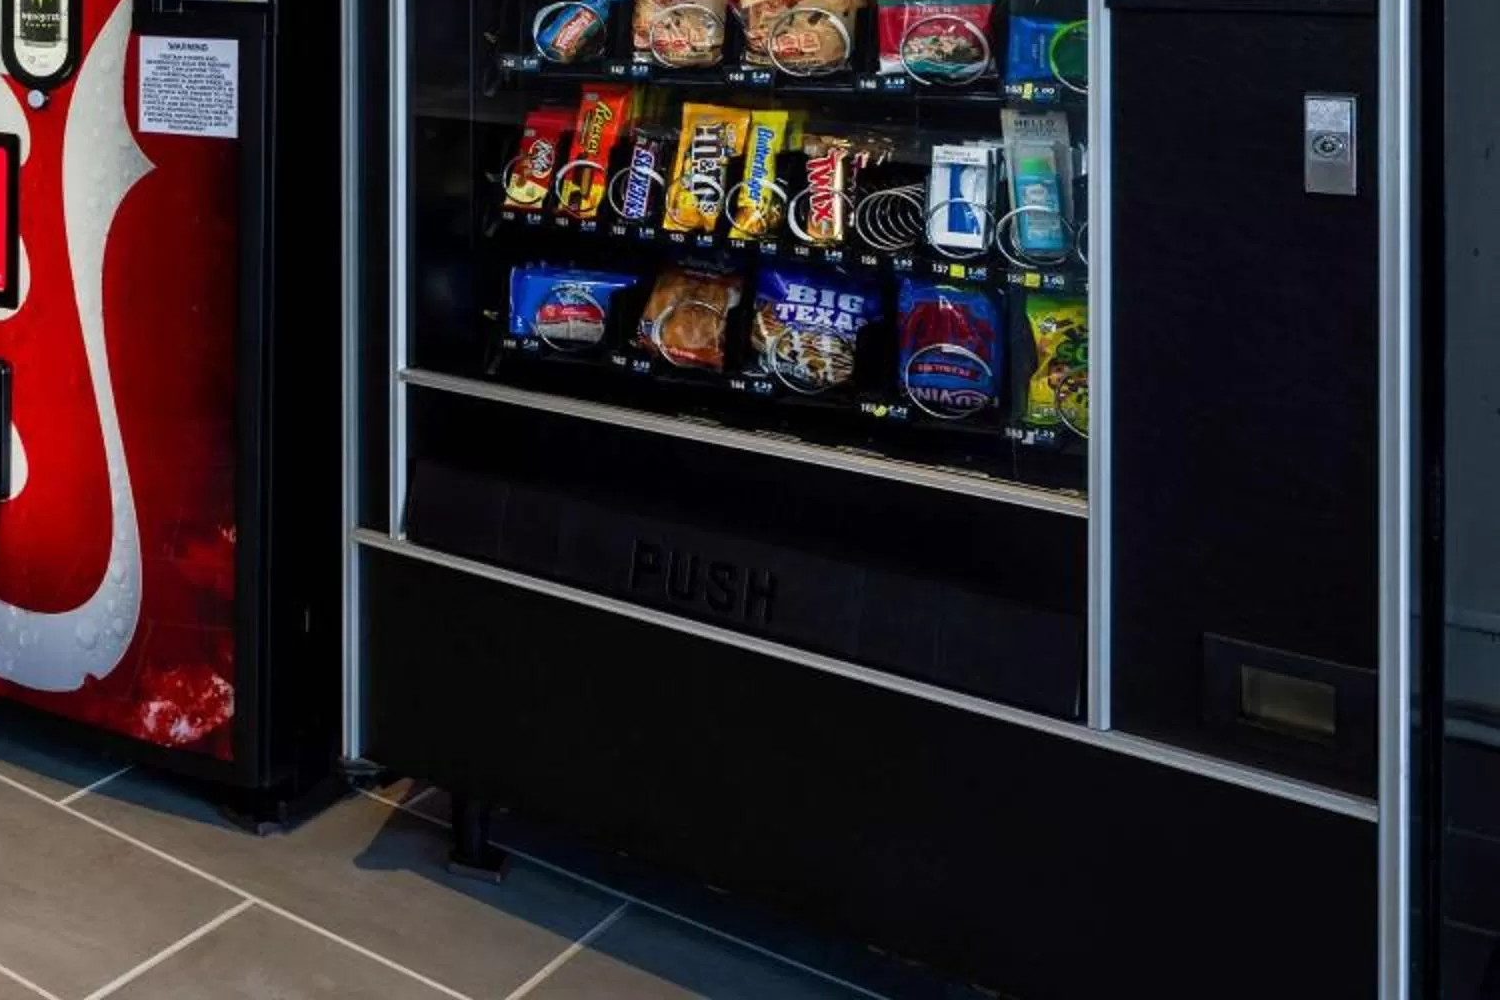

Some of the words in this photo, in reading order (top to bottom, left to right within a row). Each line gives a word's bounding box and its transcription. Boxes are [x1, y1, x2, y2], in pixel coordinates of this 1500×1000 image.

[167, 41, 210, 52] WARNING
[806, 149, 848, 224] TWIX
[785, 283, 865, 313] BIG
[627, 535, 778, 625] PUSH
